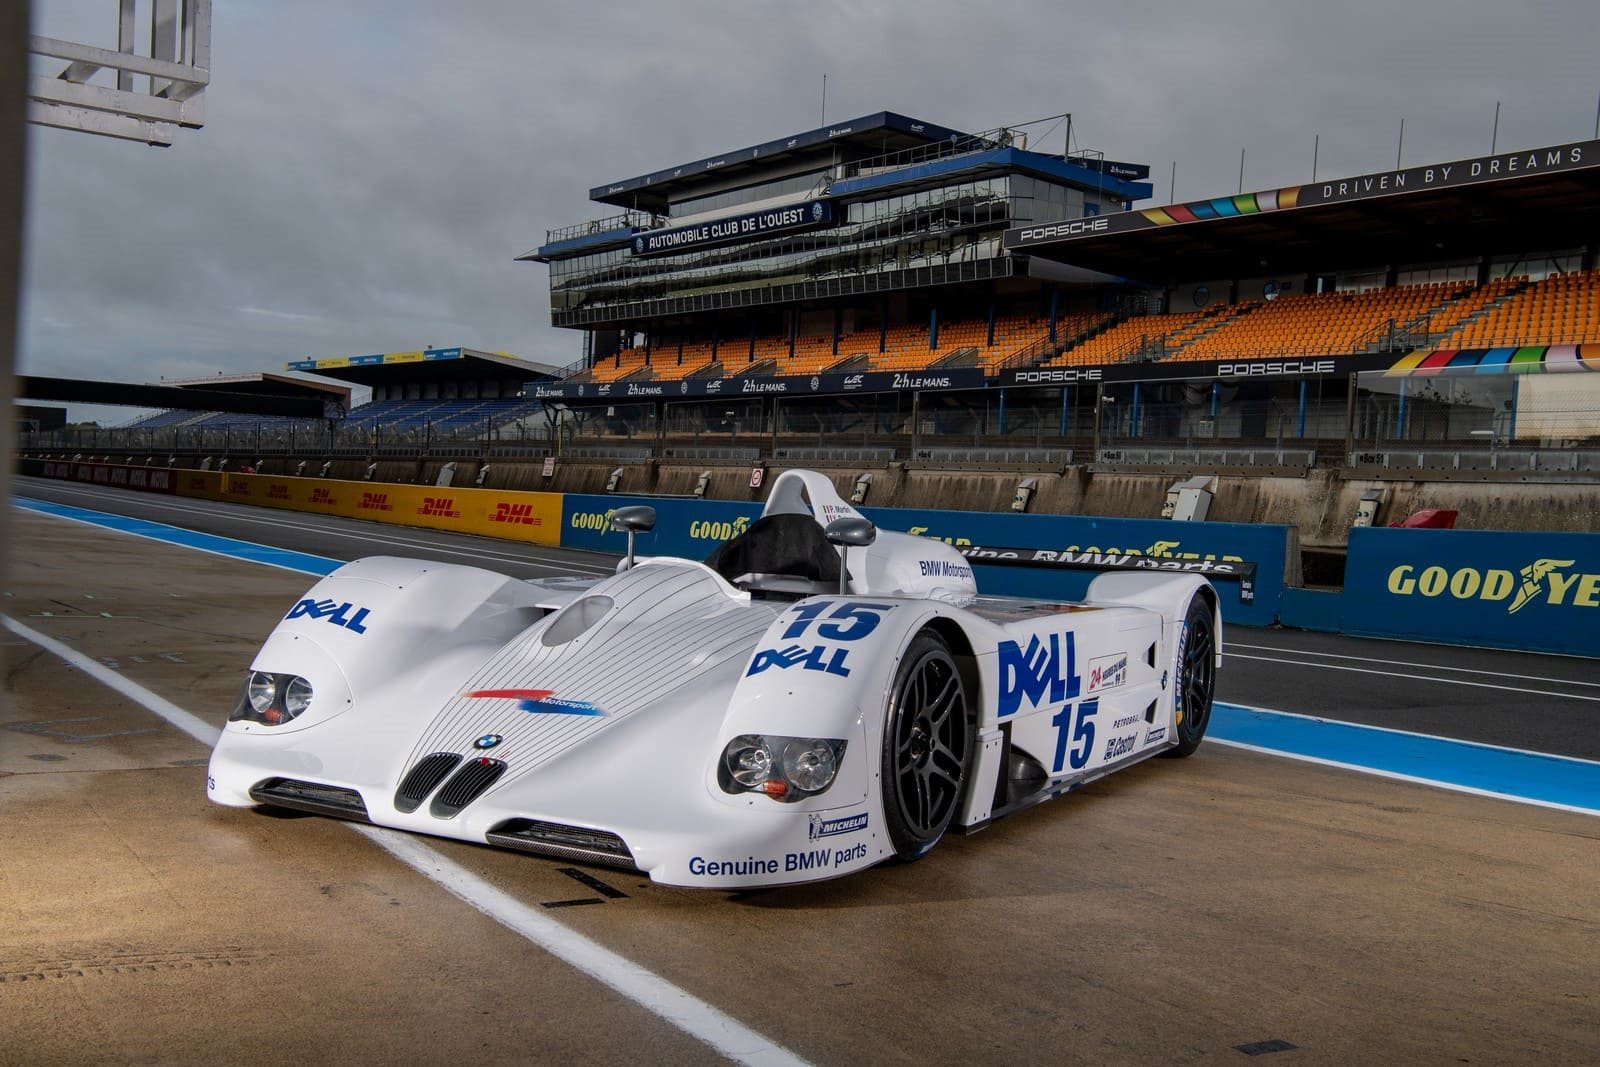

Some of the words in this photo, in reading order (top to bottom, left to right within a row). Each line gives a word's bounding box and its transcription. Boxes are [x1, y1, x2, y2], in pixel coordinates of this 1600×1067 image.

[1323, 173, 1405, 198] DRIVEN
[1424, 166, 1453, 183] BY
[1471, 147, 1582, 177] DREAMS
[649, 227, 709, 249] AUTOMOBILE
[711, 221, 739, 238] CLUB
[742, 218, 756, 232] DE
[758, 208, 805, 229] L'OUEST
[1020, 218, 1109, 242] PORSCHE
[1015, 369, 1102, 382] PORSCHE
[1217, 360, 1335, 376] PORSCHE
[638, 387, 645, 395] LE
[645, 386, 662, 395] MANS
[755, 384, 765, 392] LE
[765, 382, 787, 392] MANS
[910, 378, 922, 387] LE
[922, 377, 951, 387] MANS
[310, 487, 335, 505] DHL
[360, 492, 390, 512] DHL
[420, 497, 458, 518] DHL
[492, 502, 539, 526] DHL
[918, 560, 941, 577] BMW
[1031, 550, 1131, 565] BMW
[285, 598, 371, 635] DELL
[781, 600, 894, 642] 15
[746, 644, 851, 678] DELL
[1176, 625, 1188, 697] MICHELIN
[997, 631, 1081, 718] DELL
[1089, 666, 1102, 690] 24
[1052, 700, 1099, 773] 15
[822, 815, 867, 833] MICHELIN
[689, 856, 779, 876] Genuine
[784, 848, 832, 872] BMW
[834, 843, 867, 868] parts
